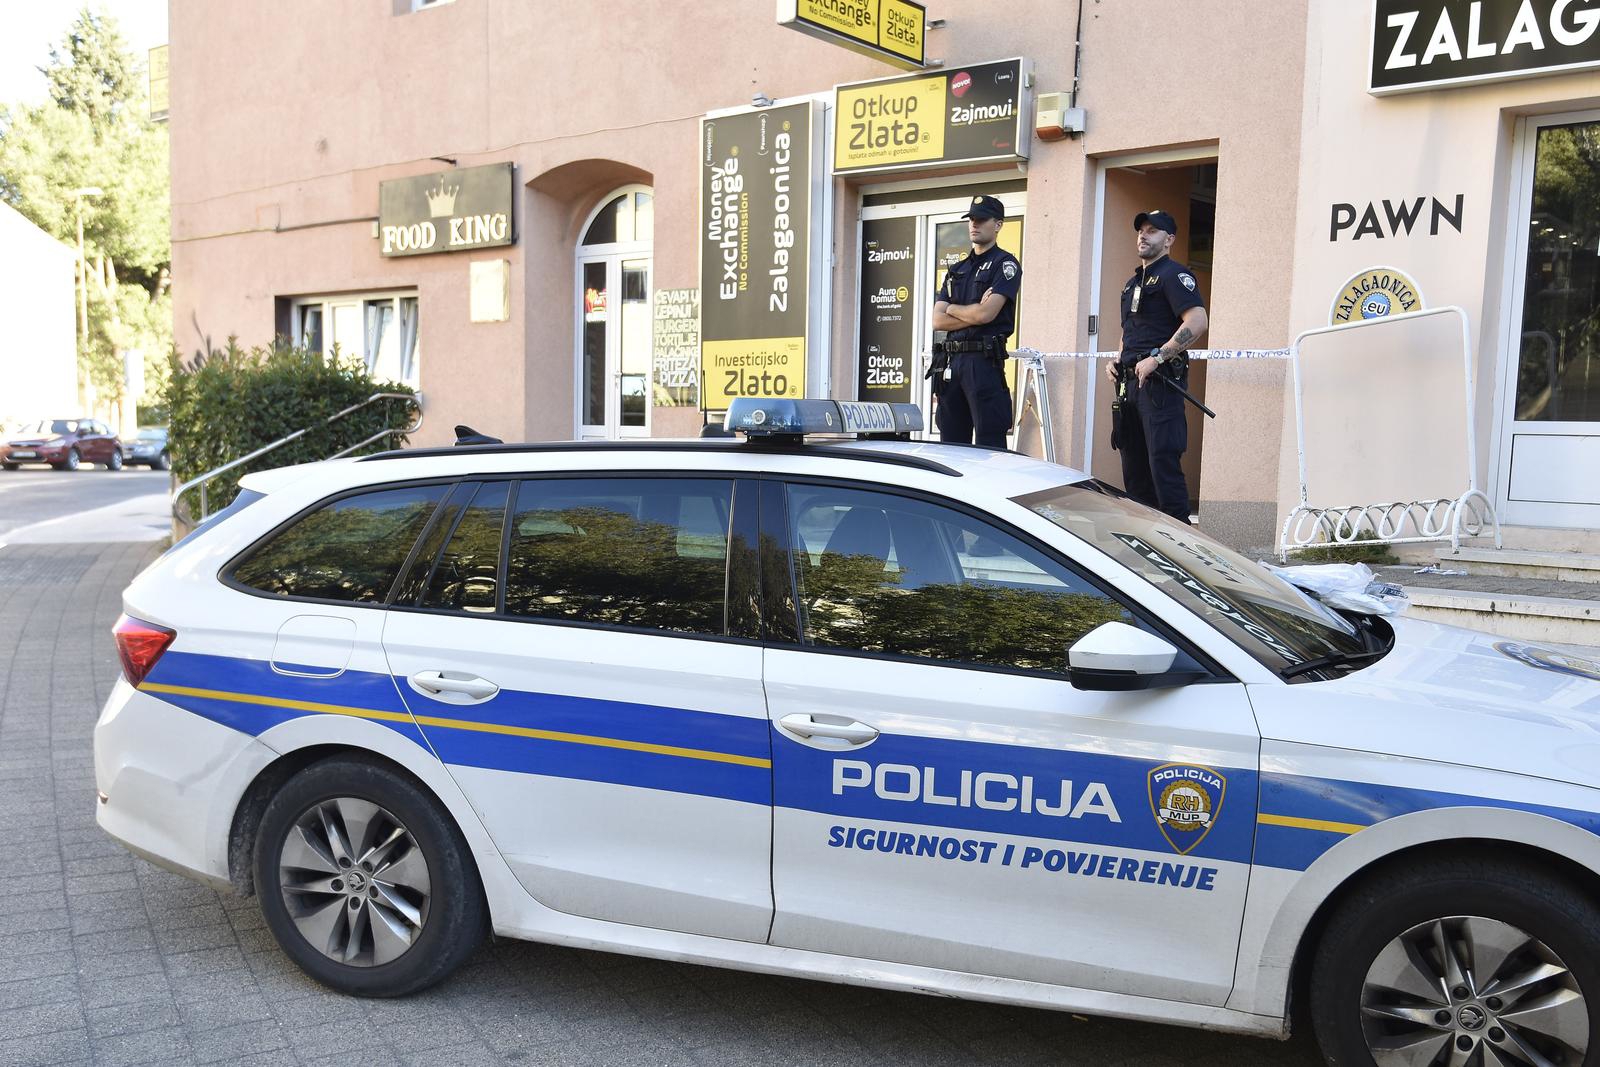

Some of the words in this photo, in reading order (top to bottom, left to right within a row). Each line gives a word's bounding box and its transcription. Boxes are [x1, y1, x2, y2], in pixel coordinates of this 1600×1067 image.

[809, 6, 818, 15] No
[819, 10, 856, 29] Commission
[888, 9, 915, 30] Otkup
[886, 21, 916, 44] Zlata
[853, 94, 918, 119] Otkup
[951, 98, 1013, 125] Zajmovi
[849, 119, 919, 150] Zlata
[708, 167, 725, 240] Money
[720, 158, 744, 300] Exchange
[769, 132, 794, 312] Zalagaonica
[1330, 193, 1464, 242] PAWN
[382, 221, 437, 253] FOOD
[449, 213, 507, 245] KING
[739, 192, 749, 269] Commission
[868, 246, 910, 264] Zajmovi
[739, 273, 748, 290] No
[878, 287, 897, 296] Auro
[870, 294, 897, 303] Domus
[1336, 275, 1416, 321] ZALAGAONICA
[715, 352, 788, 369] Investicijsko
[868, 355, 903, 370] Otkup
[660, 370, 698, 387] PIZZA
[724, 369, 788, 396] Zlato
[866, 367, 904, 384] Zlata
[843, 403, 893, 430] POLICIJA
[832, 758, 1122, 823] POLICIJA
[1154, 769, 1221, 789] POLICIJA
[1171, 793, 1200, 811] RH
[1169, 811, 1200, 821] MUP
[827, 825, 997, 864] SIGURNOST
[1001, 844, 1015, 866] I
[1021, 846, 1218, 891] POVJERENJE
